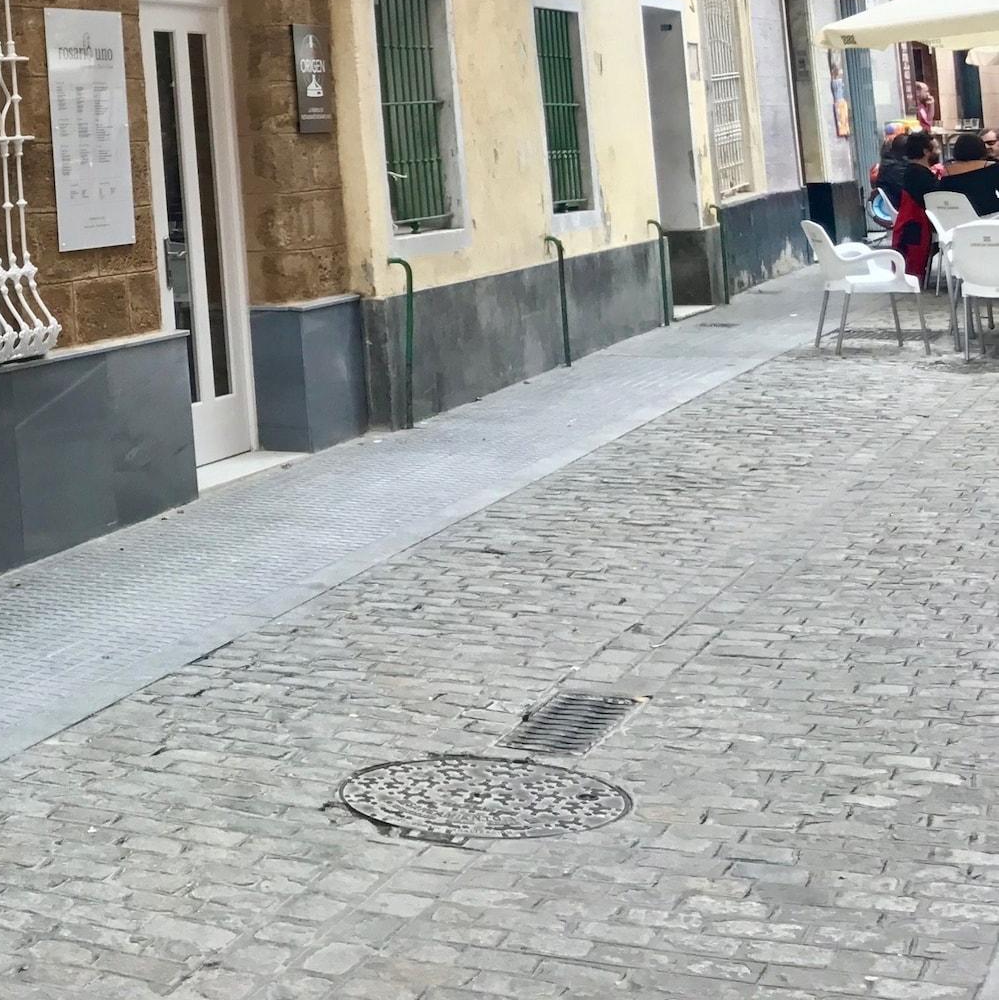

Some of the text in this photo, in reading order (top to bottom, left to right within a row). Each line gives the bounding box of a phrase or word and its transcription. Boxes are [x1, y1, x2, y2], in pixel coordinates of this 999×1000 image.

[59, 38, 113, 62] rosario uno
[300, 59, 326, 73] ORIGEN
